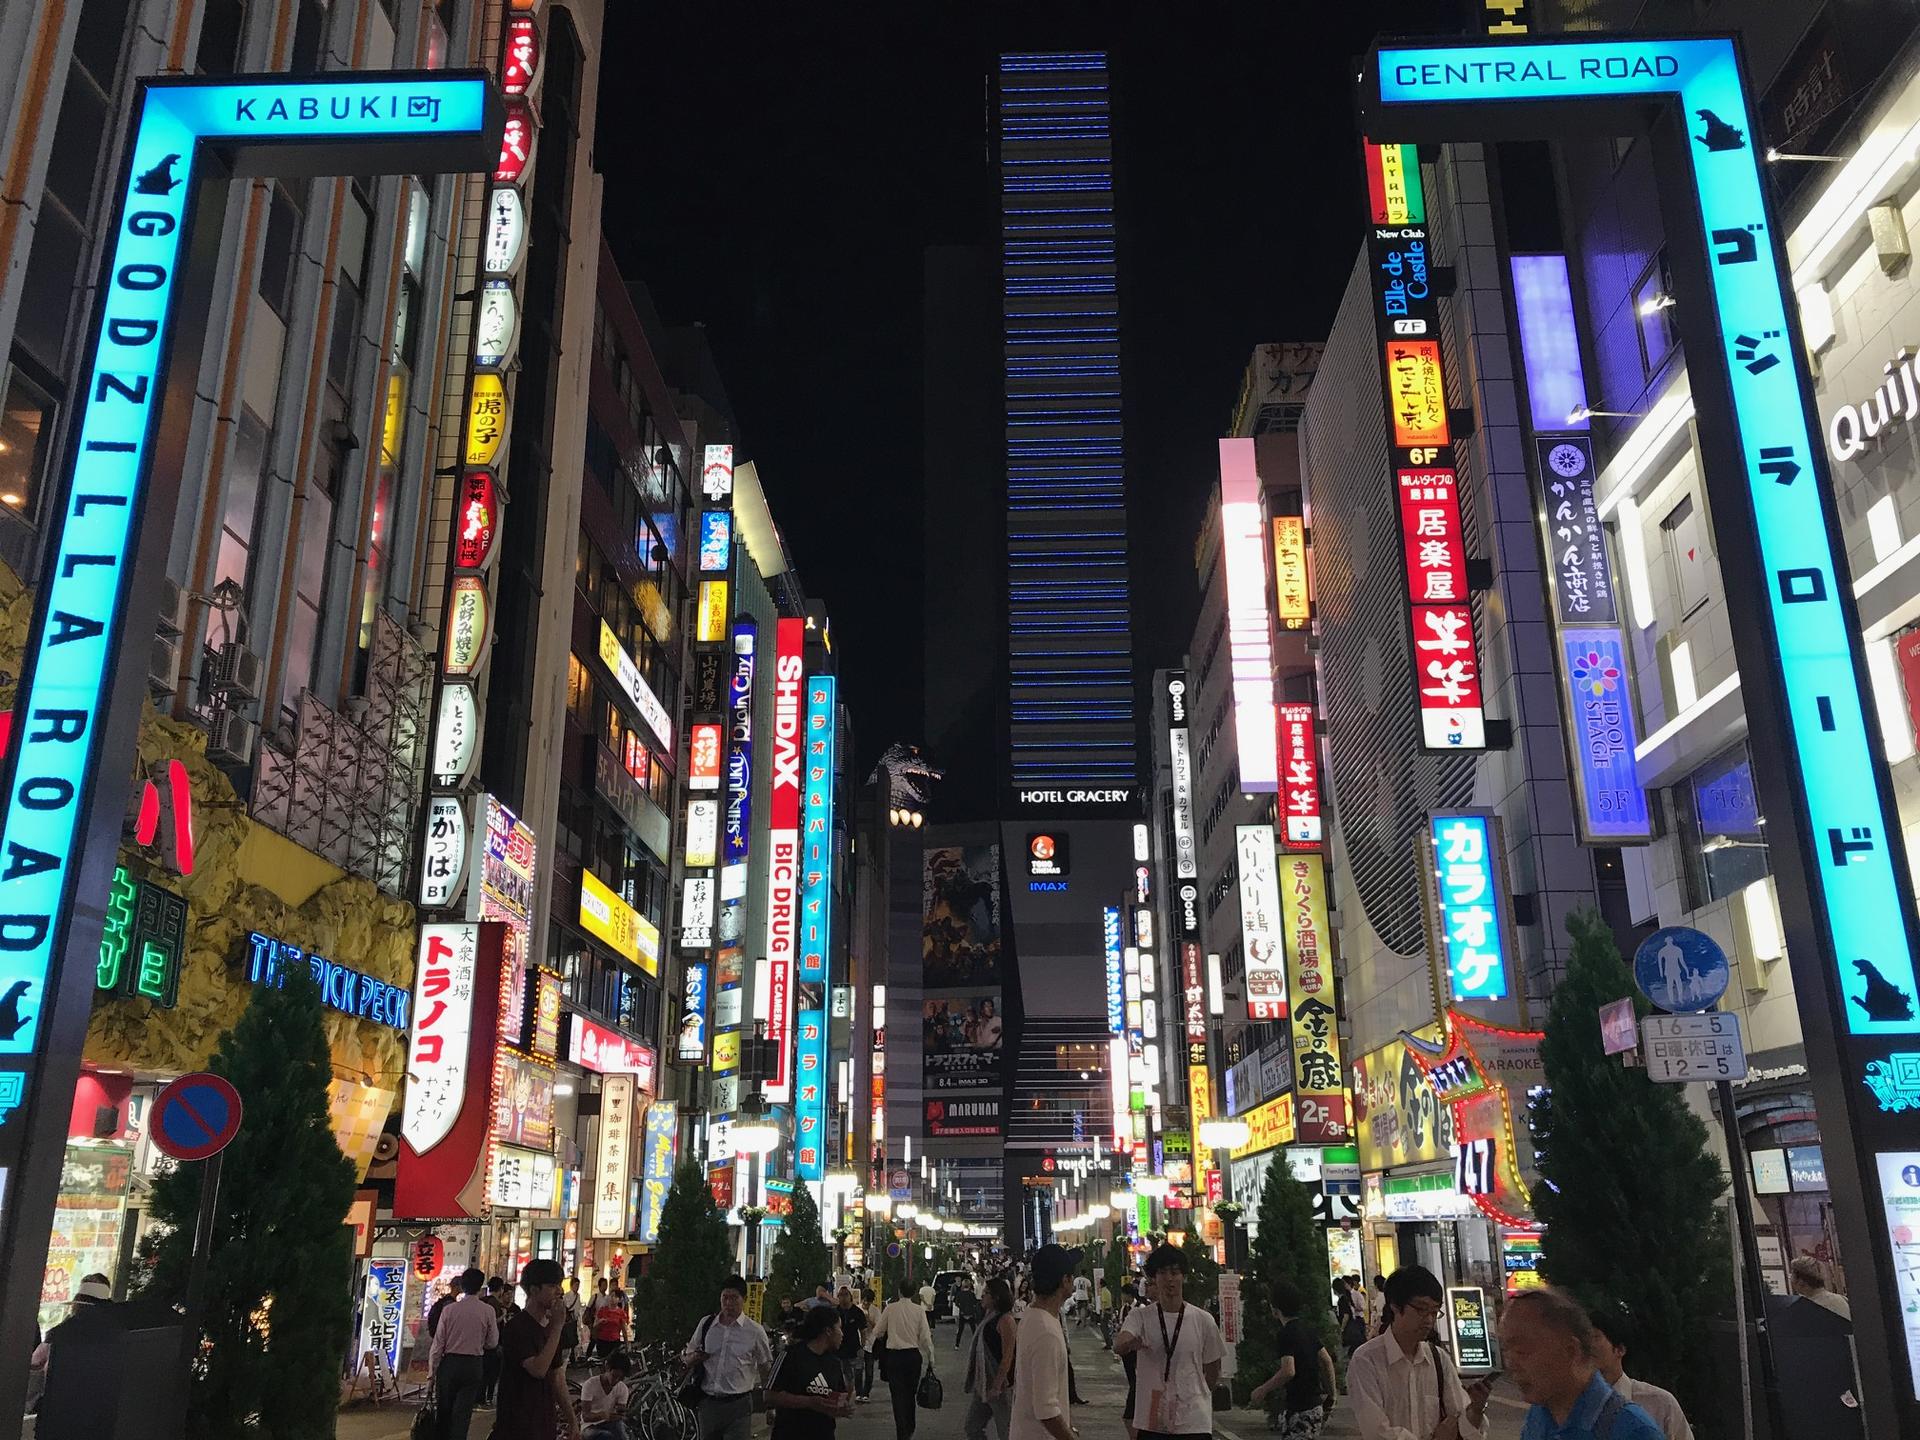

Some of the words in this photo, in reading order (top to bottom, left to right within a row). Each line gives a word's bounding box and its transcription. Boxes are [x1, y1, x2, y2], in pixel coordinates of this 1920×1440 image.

[1395, 60, 1567, 86] CENTRAL
[1580, 55, 1680, 79] ROAD
[496, 171, 516, 180] 7F
[1376, 229, 1400, 239] New
[1400, 228, 1426, 239] Club
[487, 258, 511, 271] 6F
[1381, 251, 1403, 277] de
[1403, 240, 1429, 300] Castle
[1384, 278, 1408, 316] Elle
[1398, 321, 1423, 333] 7F
[481, 356, 497, 365] 5F
[473, 398, 501, 444] 虎の子
[1829, 343, 1920, 462] Quij
[47, 209, 176, 647] GODZILLA
[468, 452, 487, 462] 4F
[1409, 448, 1439, 465] 6F
[1400, 475, 1453, 486] 新しいタイプの
[1416, 508, 1456, 600] 居楽屋
[1550, 480, 1592, 614] かんかん商店
[1711, 223, 1874, 867] ゴジラロード
[454, 593, 476, 665] お好み焼き
[1286, 619, 1304, 629] 6F
[603, 632, 616, 663] 3F
[1168, 679, 1186, 722] Booth
[773, 655, 803, 791] SHIDAX
[1585, 701, 1611, 770] STAGE
[1602, 701, 1625, 757] IDOL
[1175, 733, 1186, 782] ネットカフェ
[438, 775, 457, 786] 1F
[726, 756, 750, 835] SHINJUKU
[1020, 791, 1065, 803] HOTEL
[1066, 790, 1130, 803] GRACERY
[432, 805, 457, 816] 新宿
[1598, 790, 1630, 811] 5F
[427, 819, 456, 878] かっぱ
[774, 842, 793, 881] BIC
[426, 886, 448, 898] B1
[1029, 882, 1068, 891] IMAX
[771, 888, 793, 953] DRUG
[1179, 885, 1197, 931] Booth
[1292, 860, 1319, 970] きんくら酒場
[1442, 821, 1499, 992] カラオケ
[250, 931, 303, 990] TH
[359, 974, 411, 1030] PECK
[452, 927, 475, 1001] 大衆酒場
[1302, 971, 1318, 979] KIN
[415, 936, 454, 1064] トラノコ
[685, 966, 703, 1011] 海の家
[1301, 983, 1323, 992] KURA
[1254, 1002, 1279, 1019] B1
[925, 1052, 1000, 1067] トランスフォーマー
[1190, 1043, 1206, 1053] 4F
[1190, 1053, 1206, 1063] 3F
[1294, 997, 1342, 1090] 金の蔵
[798, 1023, 819, 1165] カラオケ館
[1427, 1057, 1472, 1093] カラオケ
[948, 1102, 999, 1117] MARUHAN
[1301, 1099, 1329, 1123] 2F
[606, 1113, 623, 1175] 珈琲茶館
[383, 1267, 404, 1322] 立呑み
[806, 1384, 833, 1397] adidas
